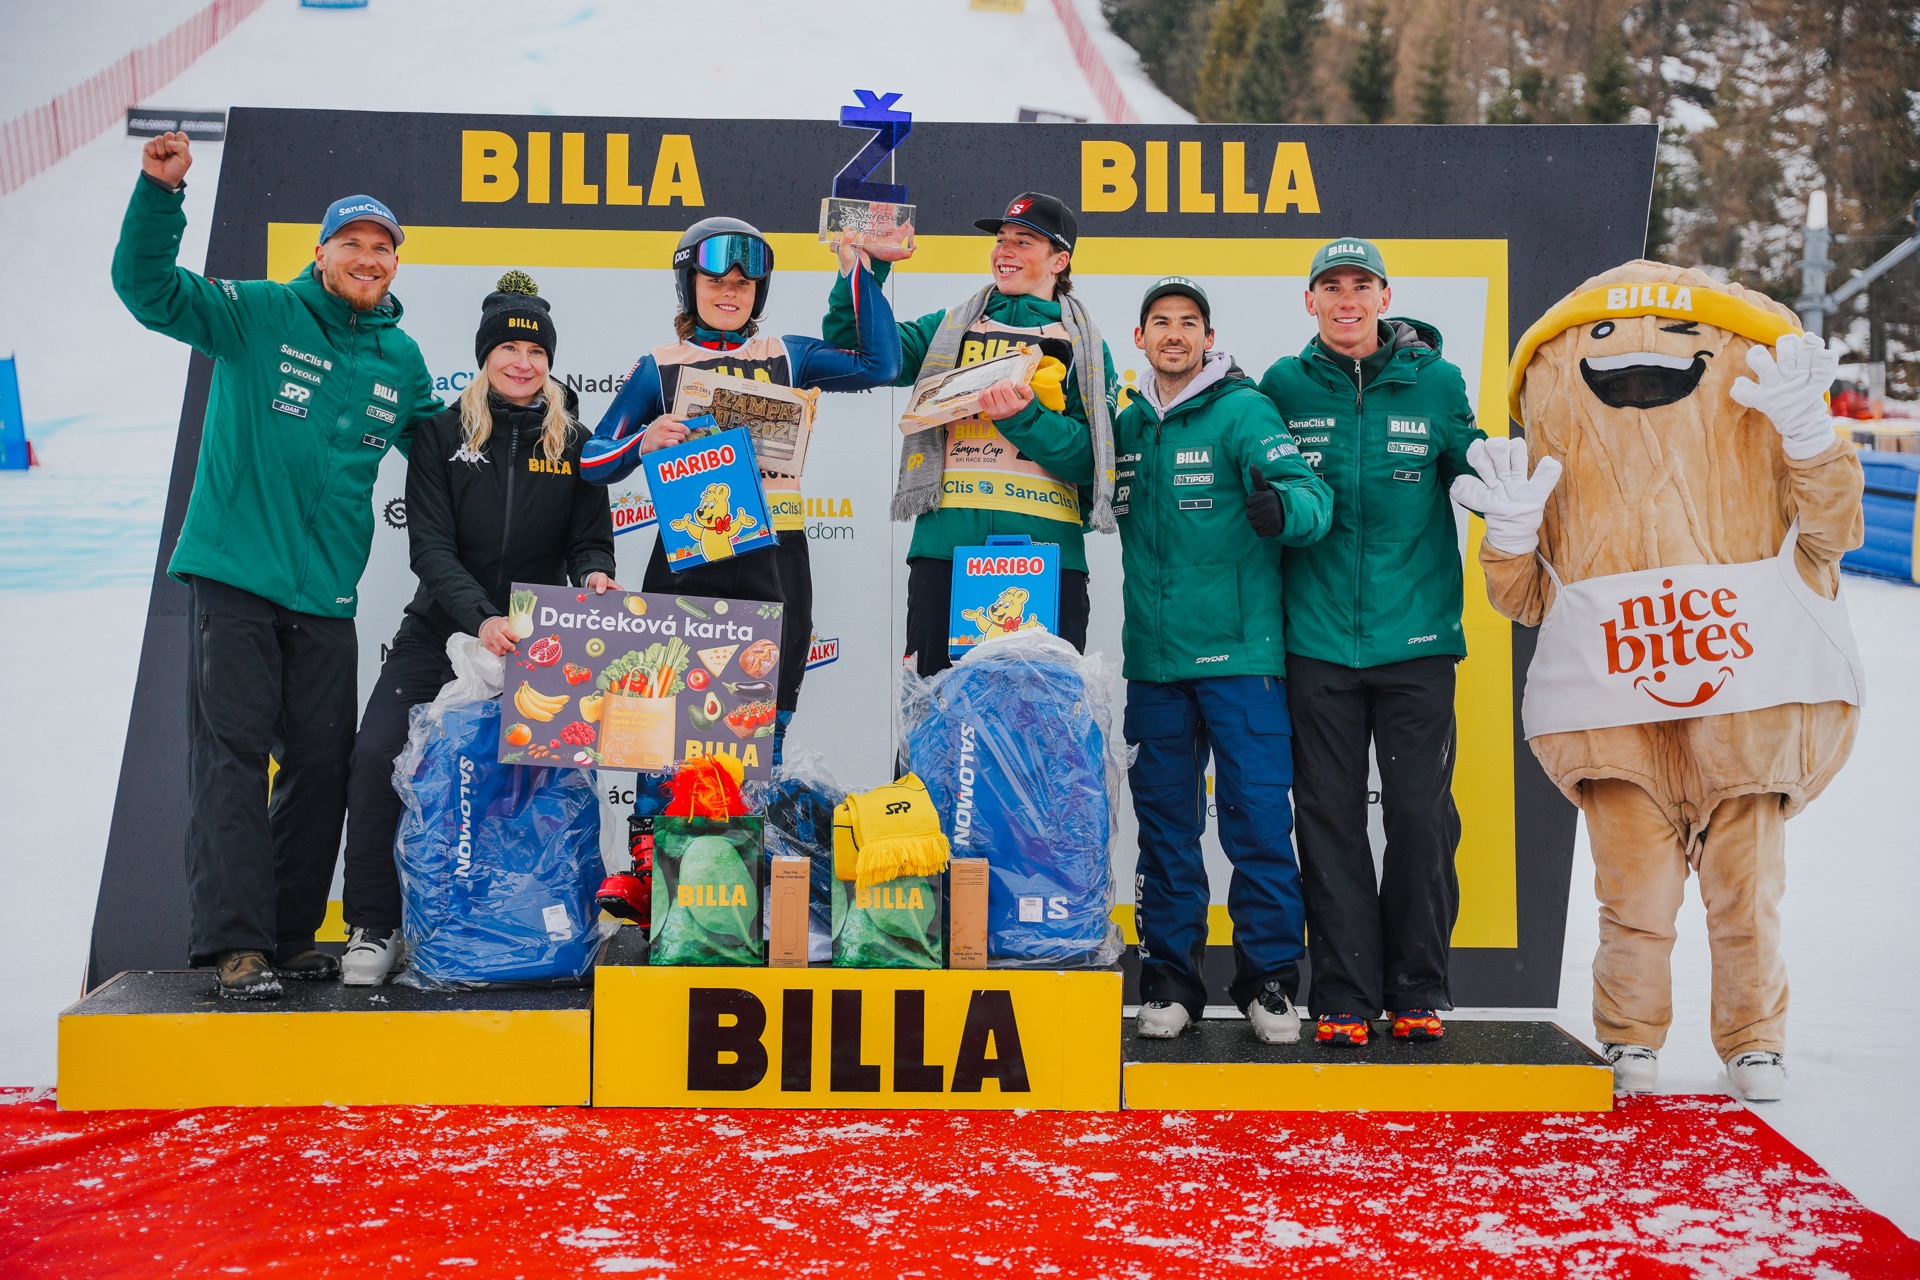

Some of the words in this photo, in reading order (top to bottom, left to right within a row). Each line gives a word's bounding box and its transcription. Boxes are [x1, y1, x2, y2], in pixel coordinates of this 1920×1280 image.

[461, 130, 705, 207] BILLA
[1081, 140, 1321, 214] BILLA
[1327, 243, 1366, 257] BILLA
[1160, 277, 1196, 289] BILLA
[1606, 285, 1693, 313] BILLA
[508, 317, 539, 331] BILLA
[280, 344, 323, 367] SanaClis
[292, 369, 321, 384] VEOLIA
[280, 382, 310, 403] SPP
[373, 383, 398, 404] BILLA
[279, 403, 300, 414] ADAM
[375, 407, 395, 422] TIPOS
[954, 423, 999, 440] BILLA
[1288, 418, 1325, 429] SanaClis
[1390, 420, 1427, 435] BILLA
[1302, 436, 1329, 444] VEOLIA
[1400, 445, 1426, 454] TIPOS
[982, 443, 1004, 458] Cup
[1175, 450, 1210, 465] BILLA
[528, 458, 572, 475] BILLA
[659, 446, 735, 482] HARIBO
[1184, 475, 1211, 484] TIPOS
[1004, 482, 1073, 509] SanaClis
[967, 557, 1044, 576] HARIBO
[1618, 578, 1738, 631] nice
[539, 605, 677, 637] Darčeková
[684, 616, 753, 642] karta
[1408, 634, 1438, 645] SPYDER
[1195, 654, 1229, 664] SPYDER
[1600, 619, 1754, 682] bites
[684, 739, 760, 769] BILLA
[954, 721, 976, 847] SALOMON
[454, 755, 475, 878] SALOMON
[885, 801, 911, 815] SPP
[677, 884, 748, 907] BILLA
[855, 886, 924, 910] BILLA
[1047, 896, 1069, 919] S
[687, 987, 1031, 1093] BILLA
